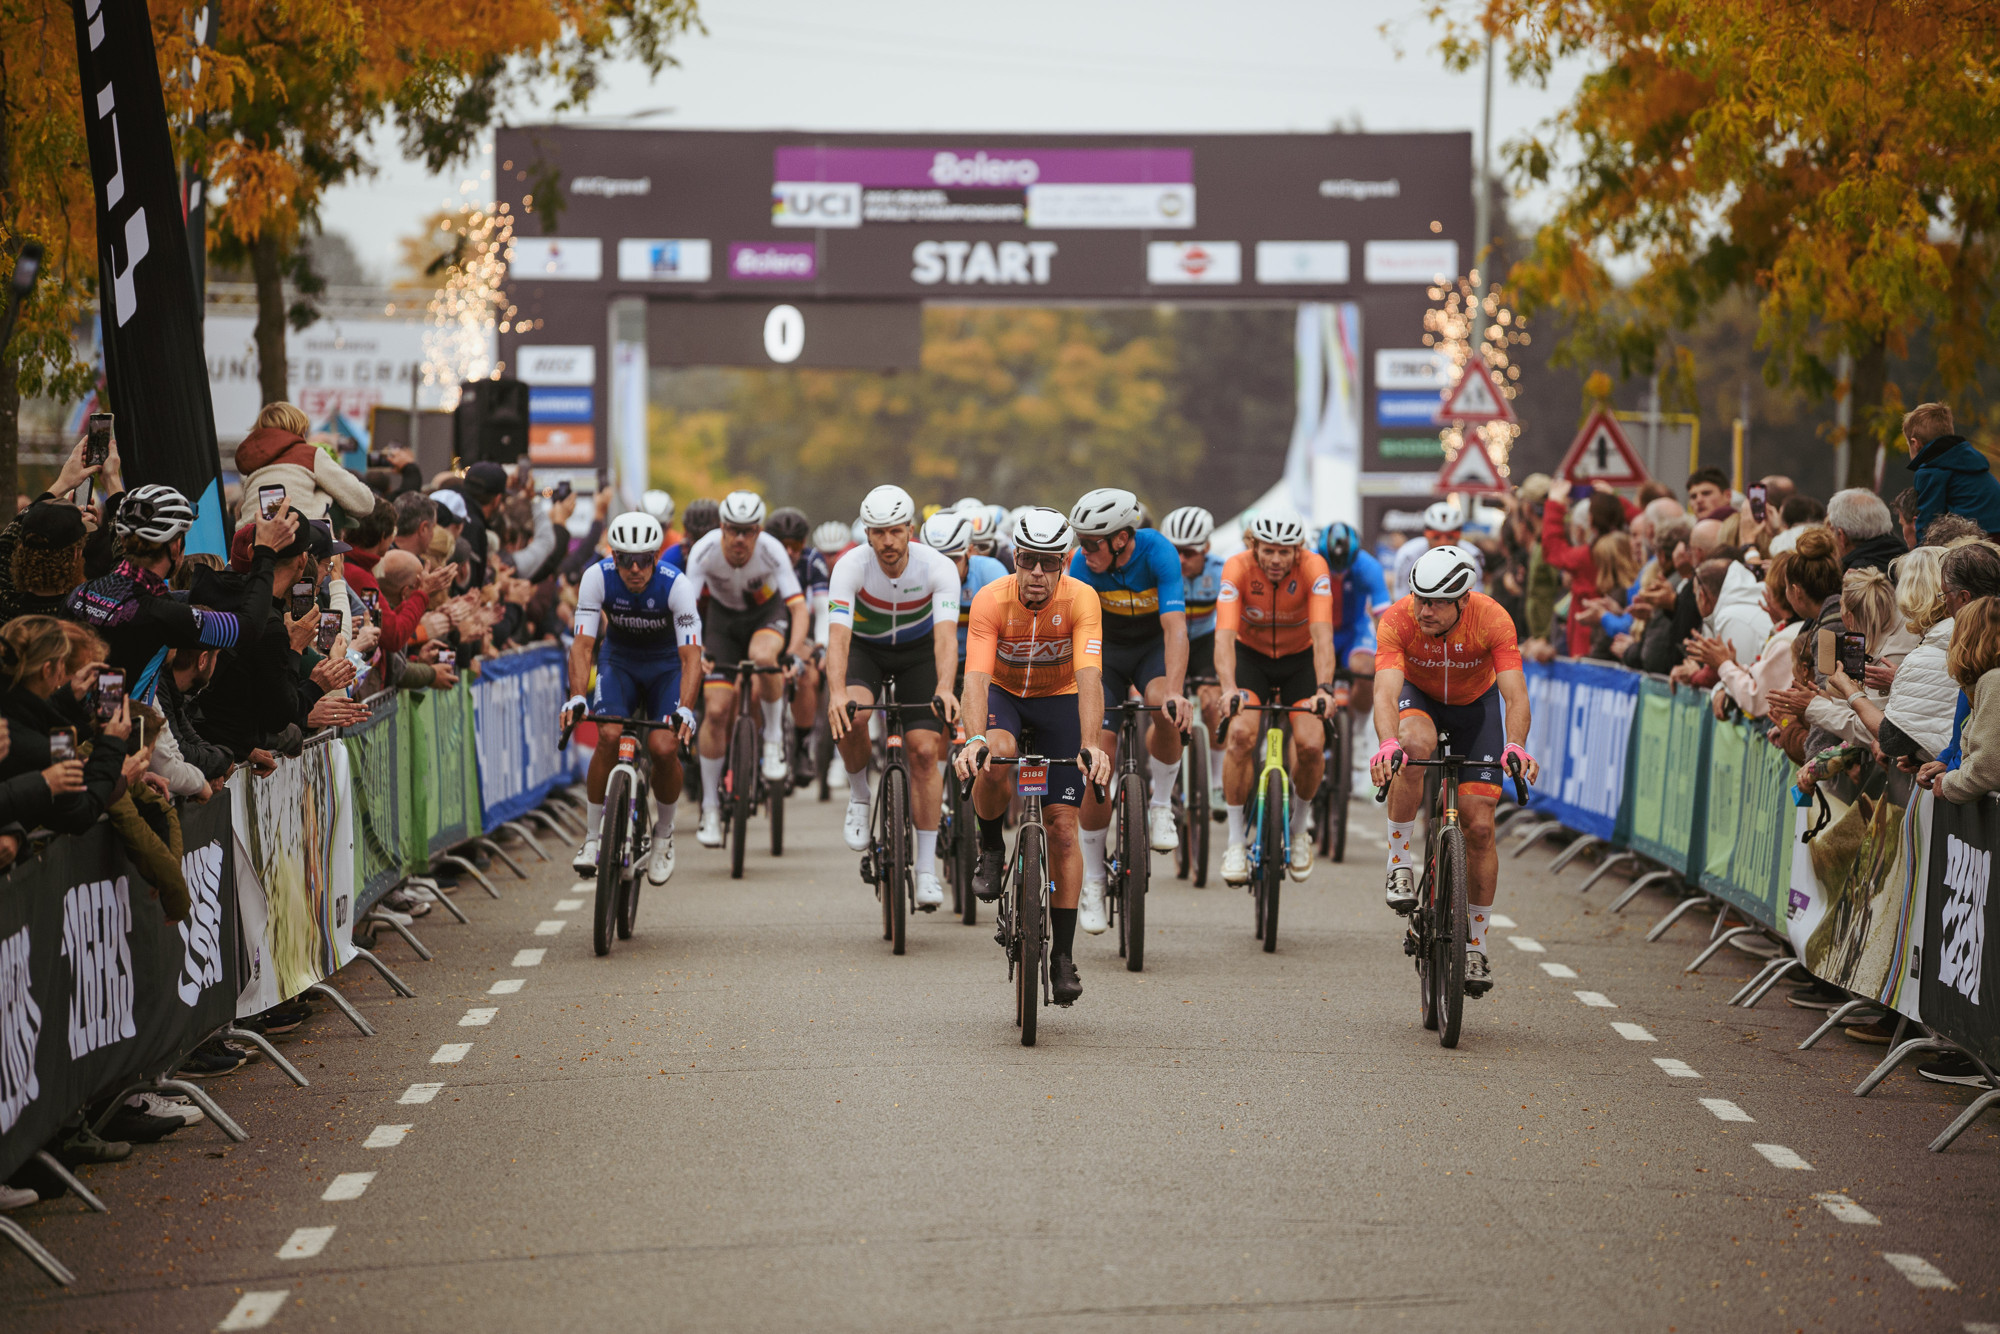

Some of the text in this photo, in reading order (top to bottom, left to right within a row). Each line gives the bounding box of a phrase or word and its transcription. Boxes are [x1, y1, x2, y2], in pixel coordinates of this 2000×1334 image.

[929, 151, 1040, 186] Bolero
[789, 191, 852, 216] UCI
[734, 247, 812, 276] Bolero
[911, 240, 1058, 285] START
[763, 304, 805, 363] 0
[998, 638, 1072, 658] BEAT
[1408, 656, 1484, 669] Rabobank
[1022, 770, 1044, 778] 5188
